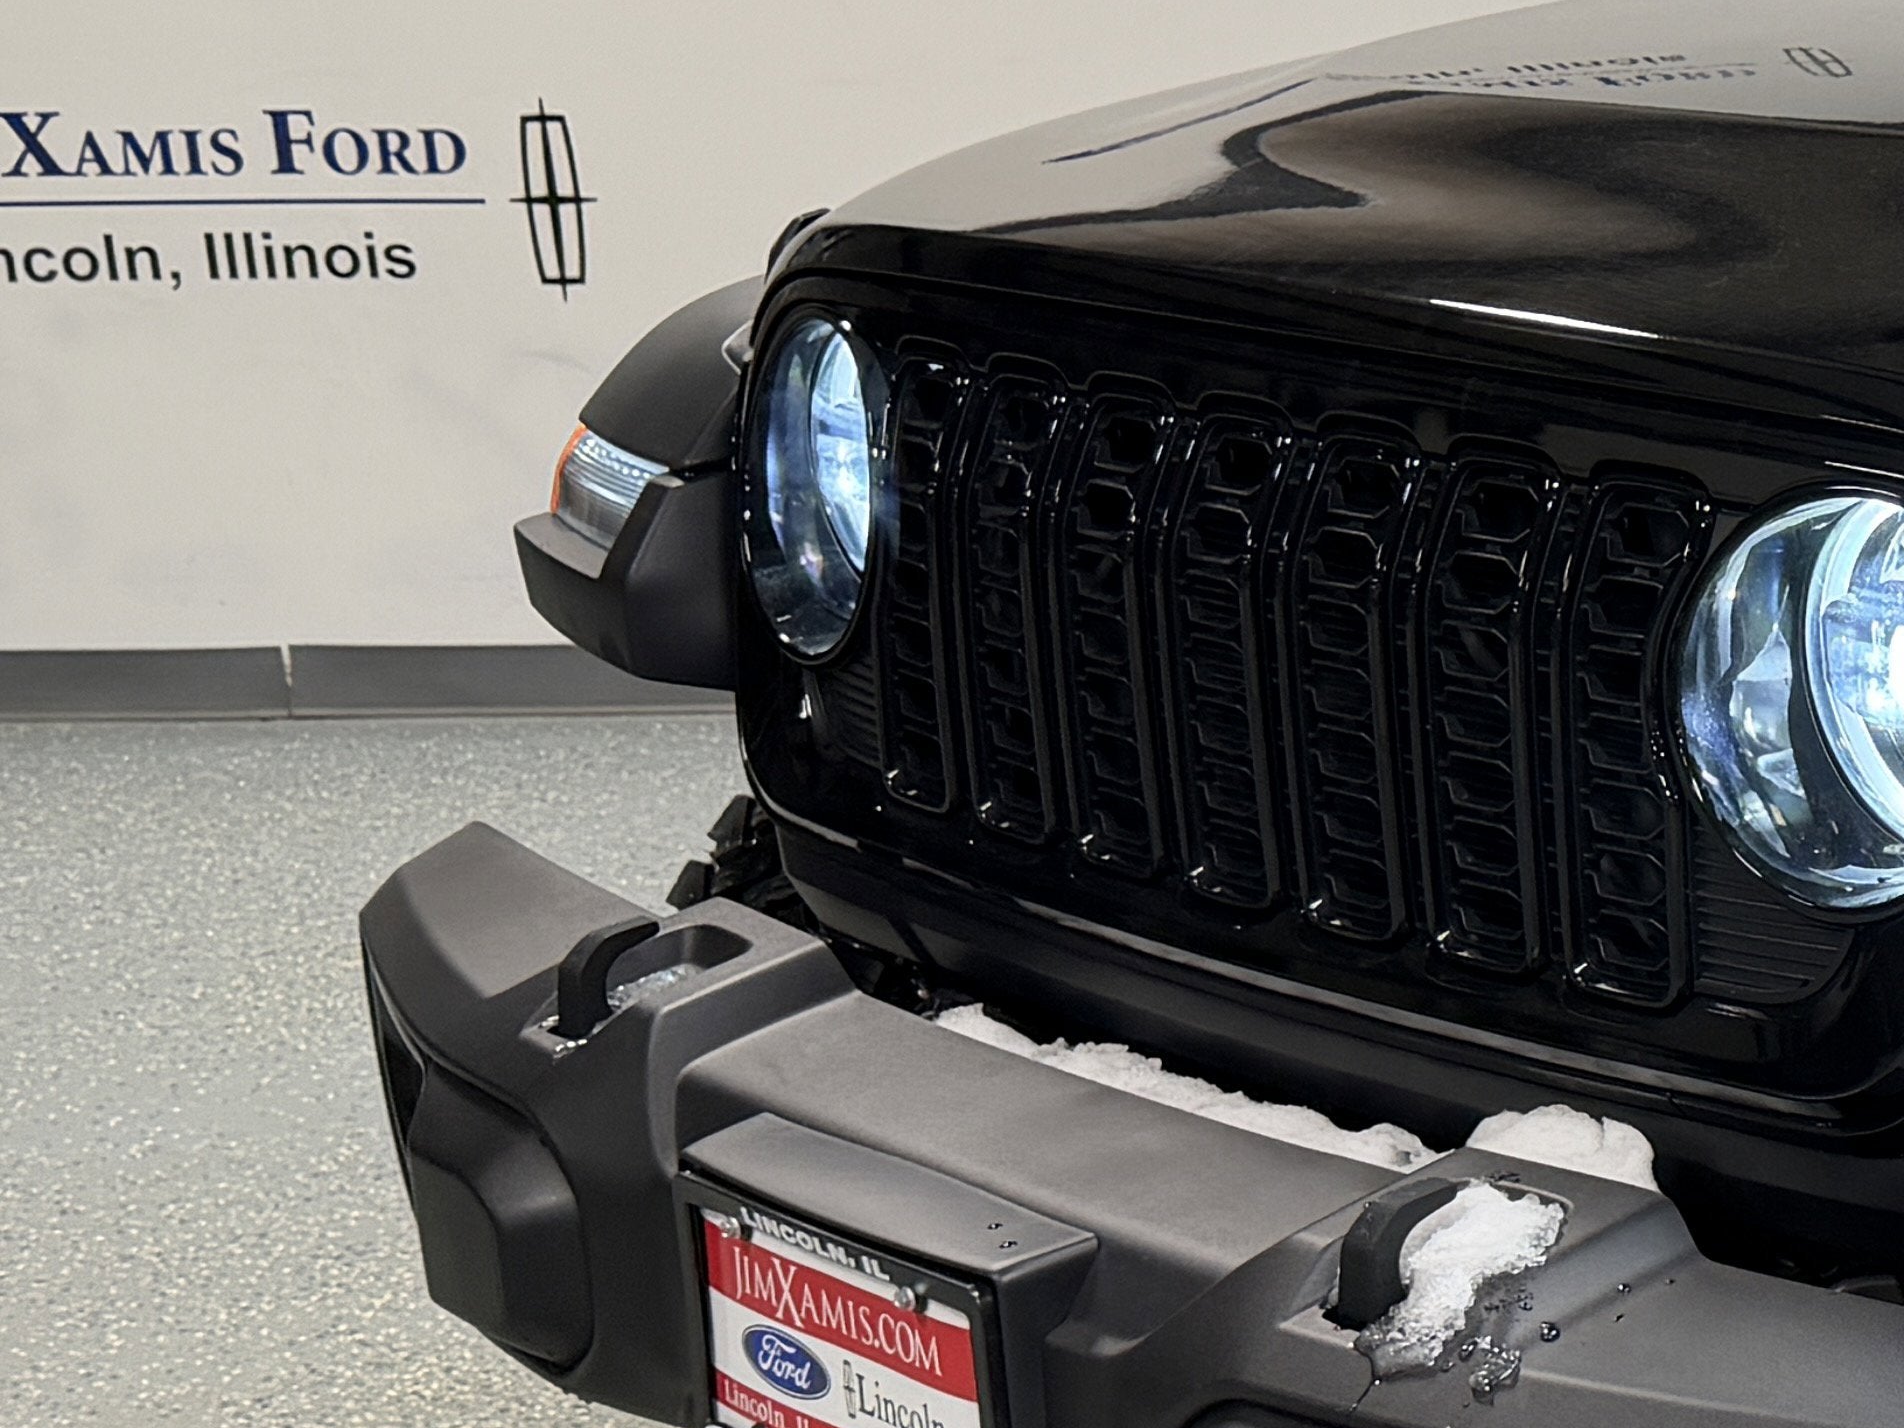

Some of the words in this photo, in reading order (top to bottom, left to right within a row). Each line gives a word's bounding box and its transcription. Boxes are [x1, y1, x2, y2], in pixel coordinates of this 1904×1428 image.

[0, 111, 243, 178] XAMIS
[263, 109, 467, 176] FORD
[203, 231, 417, 280] Illinois
[861, 1255, 891, 1282] IL
[732, 1245, 943, 1377] JIMXAMIS.COM
[757, 1333, 812, 1389] Ford
